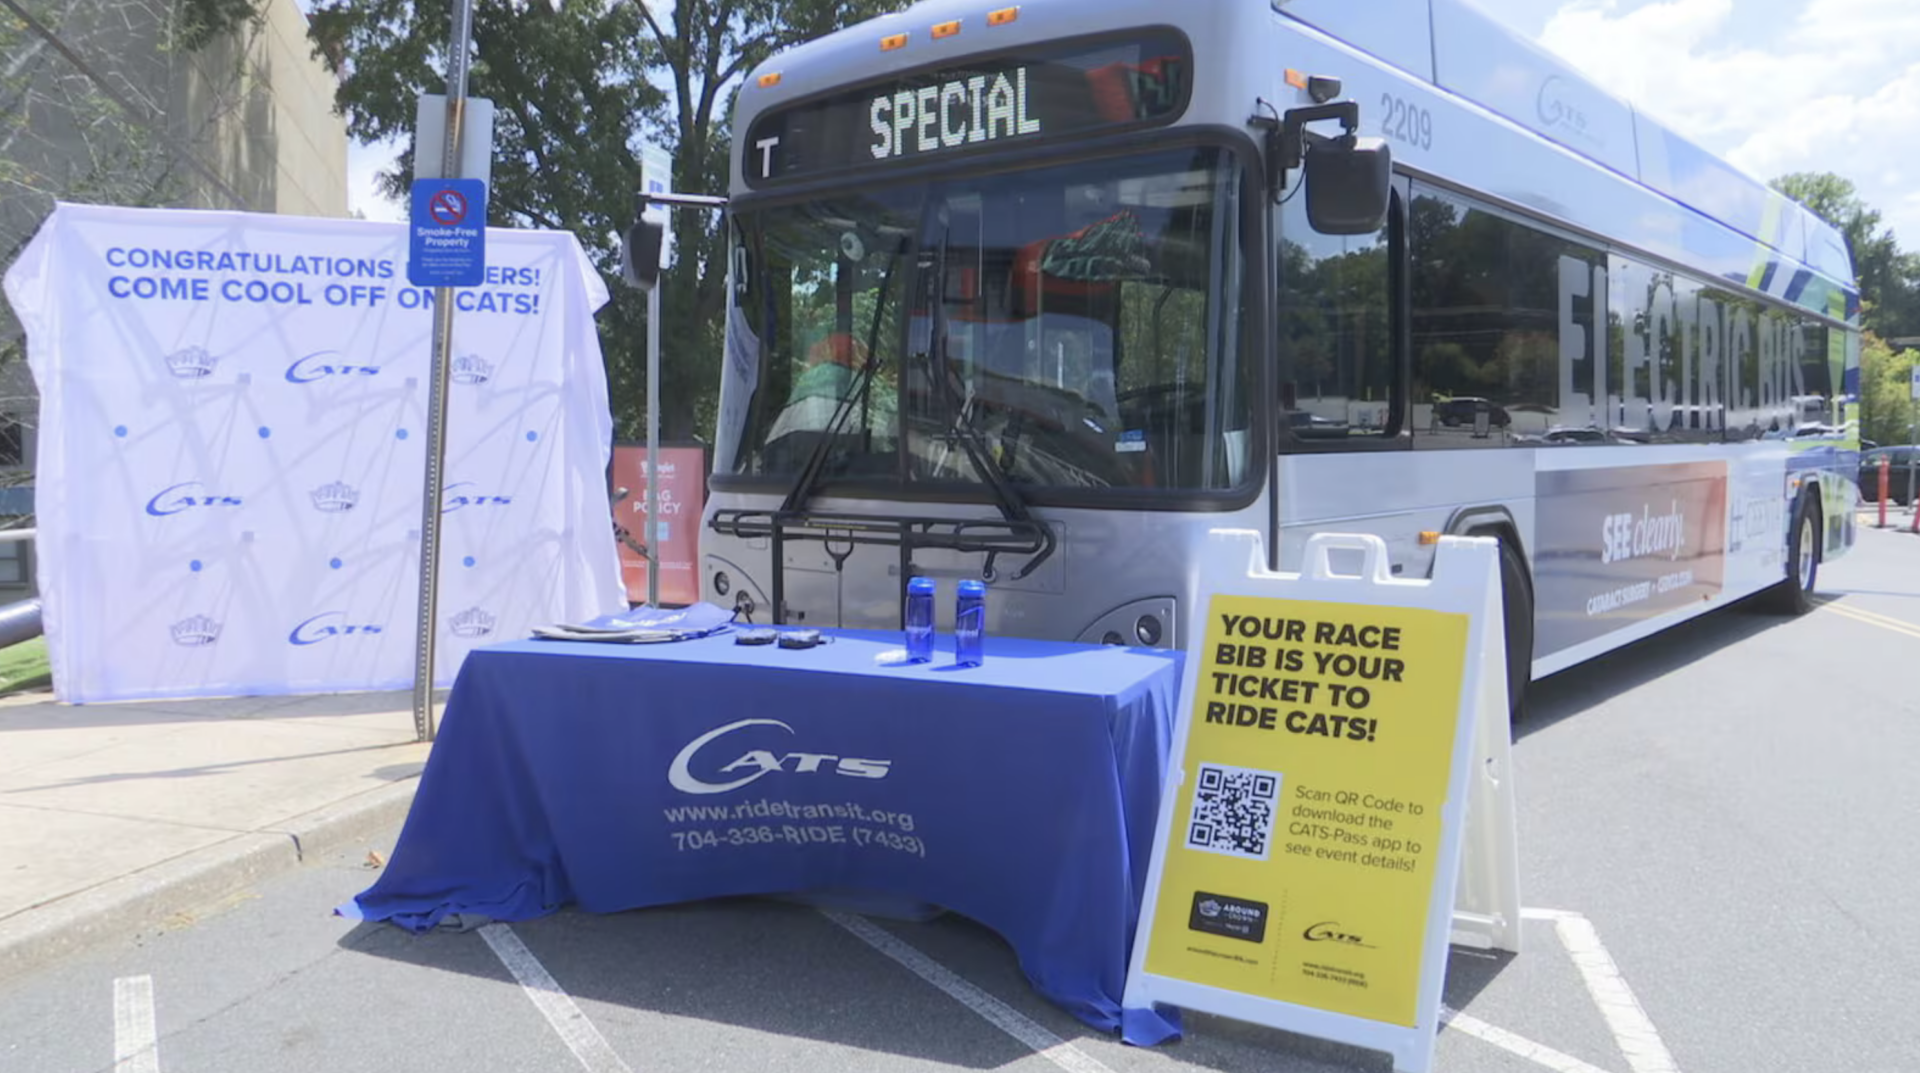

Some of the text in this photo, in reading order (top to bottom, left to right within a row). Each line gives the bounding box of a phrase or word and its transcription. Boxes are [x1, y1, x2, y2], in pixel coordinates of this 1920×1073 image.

[870, 67, 1040, 160] SPECIAL
[1381, 92, 1432, 151] 2209
[417, 227, 478, 237] Smoke-Free
[425, 237, 469, 248] Property
[106, 247, 394, 278] CONGRATULATIONS
[108, 275, 540, 314] COME COOL OFF ON CATS!
[1558, 255, 1805, 432] ELECTRIC BUS
[285, 350, 381, 384] CATS
[146, 481, 242, 517] CATS
[633, 501, 681, 514] POICY
[1602, 513, 1632, 564] SEE
[1633, 499, 1685, 562] clearly.
[289, 611, 382, 646] CATS
[1221, 614, 1401, 650] YOUR RACE
[1215, 643, 1405, 682] BIB IS YOUR
[1212, 672, 1371, 709] TICKET TO
[1205, 701, 1377, 742] RIDE CATS!
[667, 719, 892, 794] CATS
[664, 800, 914, 831] www.ridetransit.org
[1292, 804, 1393, 830] download the
[1295, 785, 1424, 815] Scan QR Code to
[671, 825, 926, 858] 704-336-RIDE (7433)
[1289, 822, 1422, 854] CATS-Pass app to
[1285, 842, 1416, 873] see event details!
[1303, 921, 1363, 943] CATS
